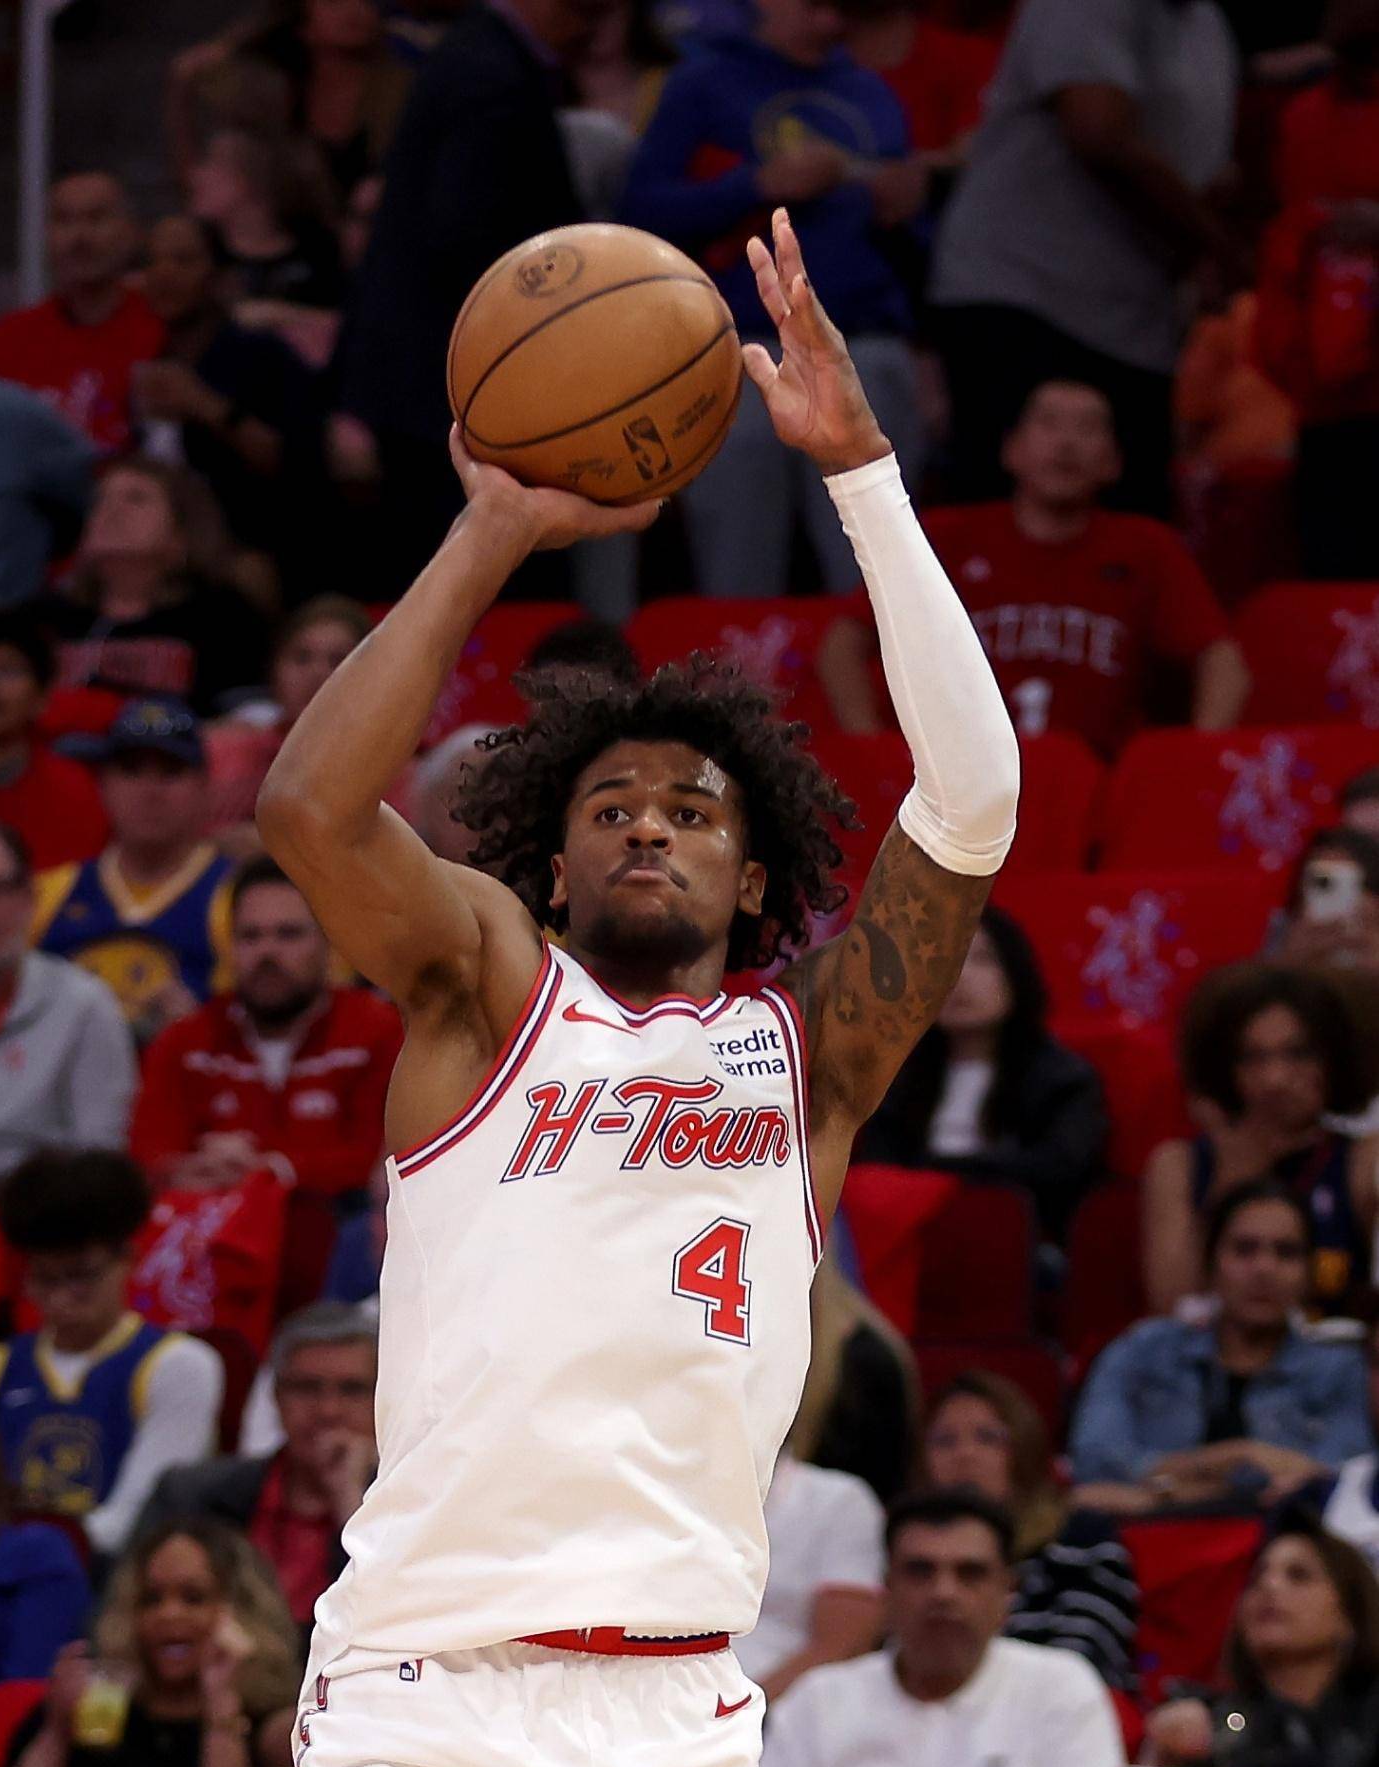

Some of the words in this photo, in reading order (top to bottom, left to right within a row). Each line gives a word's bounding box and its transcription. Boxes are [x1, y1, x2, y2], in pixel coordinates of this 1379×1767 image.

[718, 1057, 787, 1077] arma
[499, 1075, 791, 1184] H-Town
[672, 1216, 752, 1347] 4
